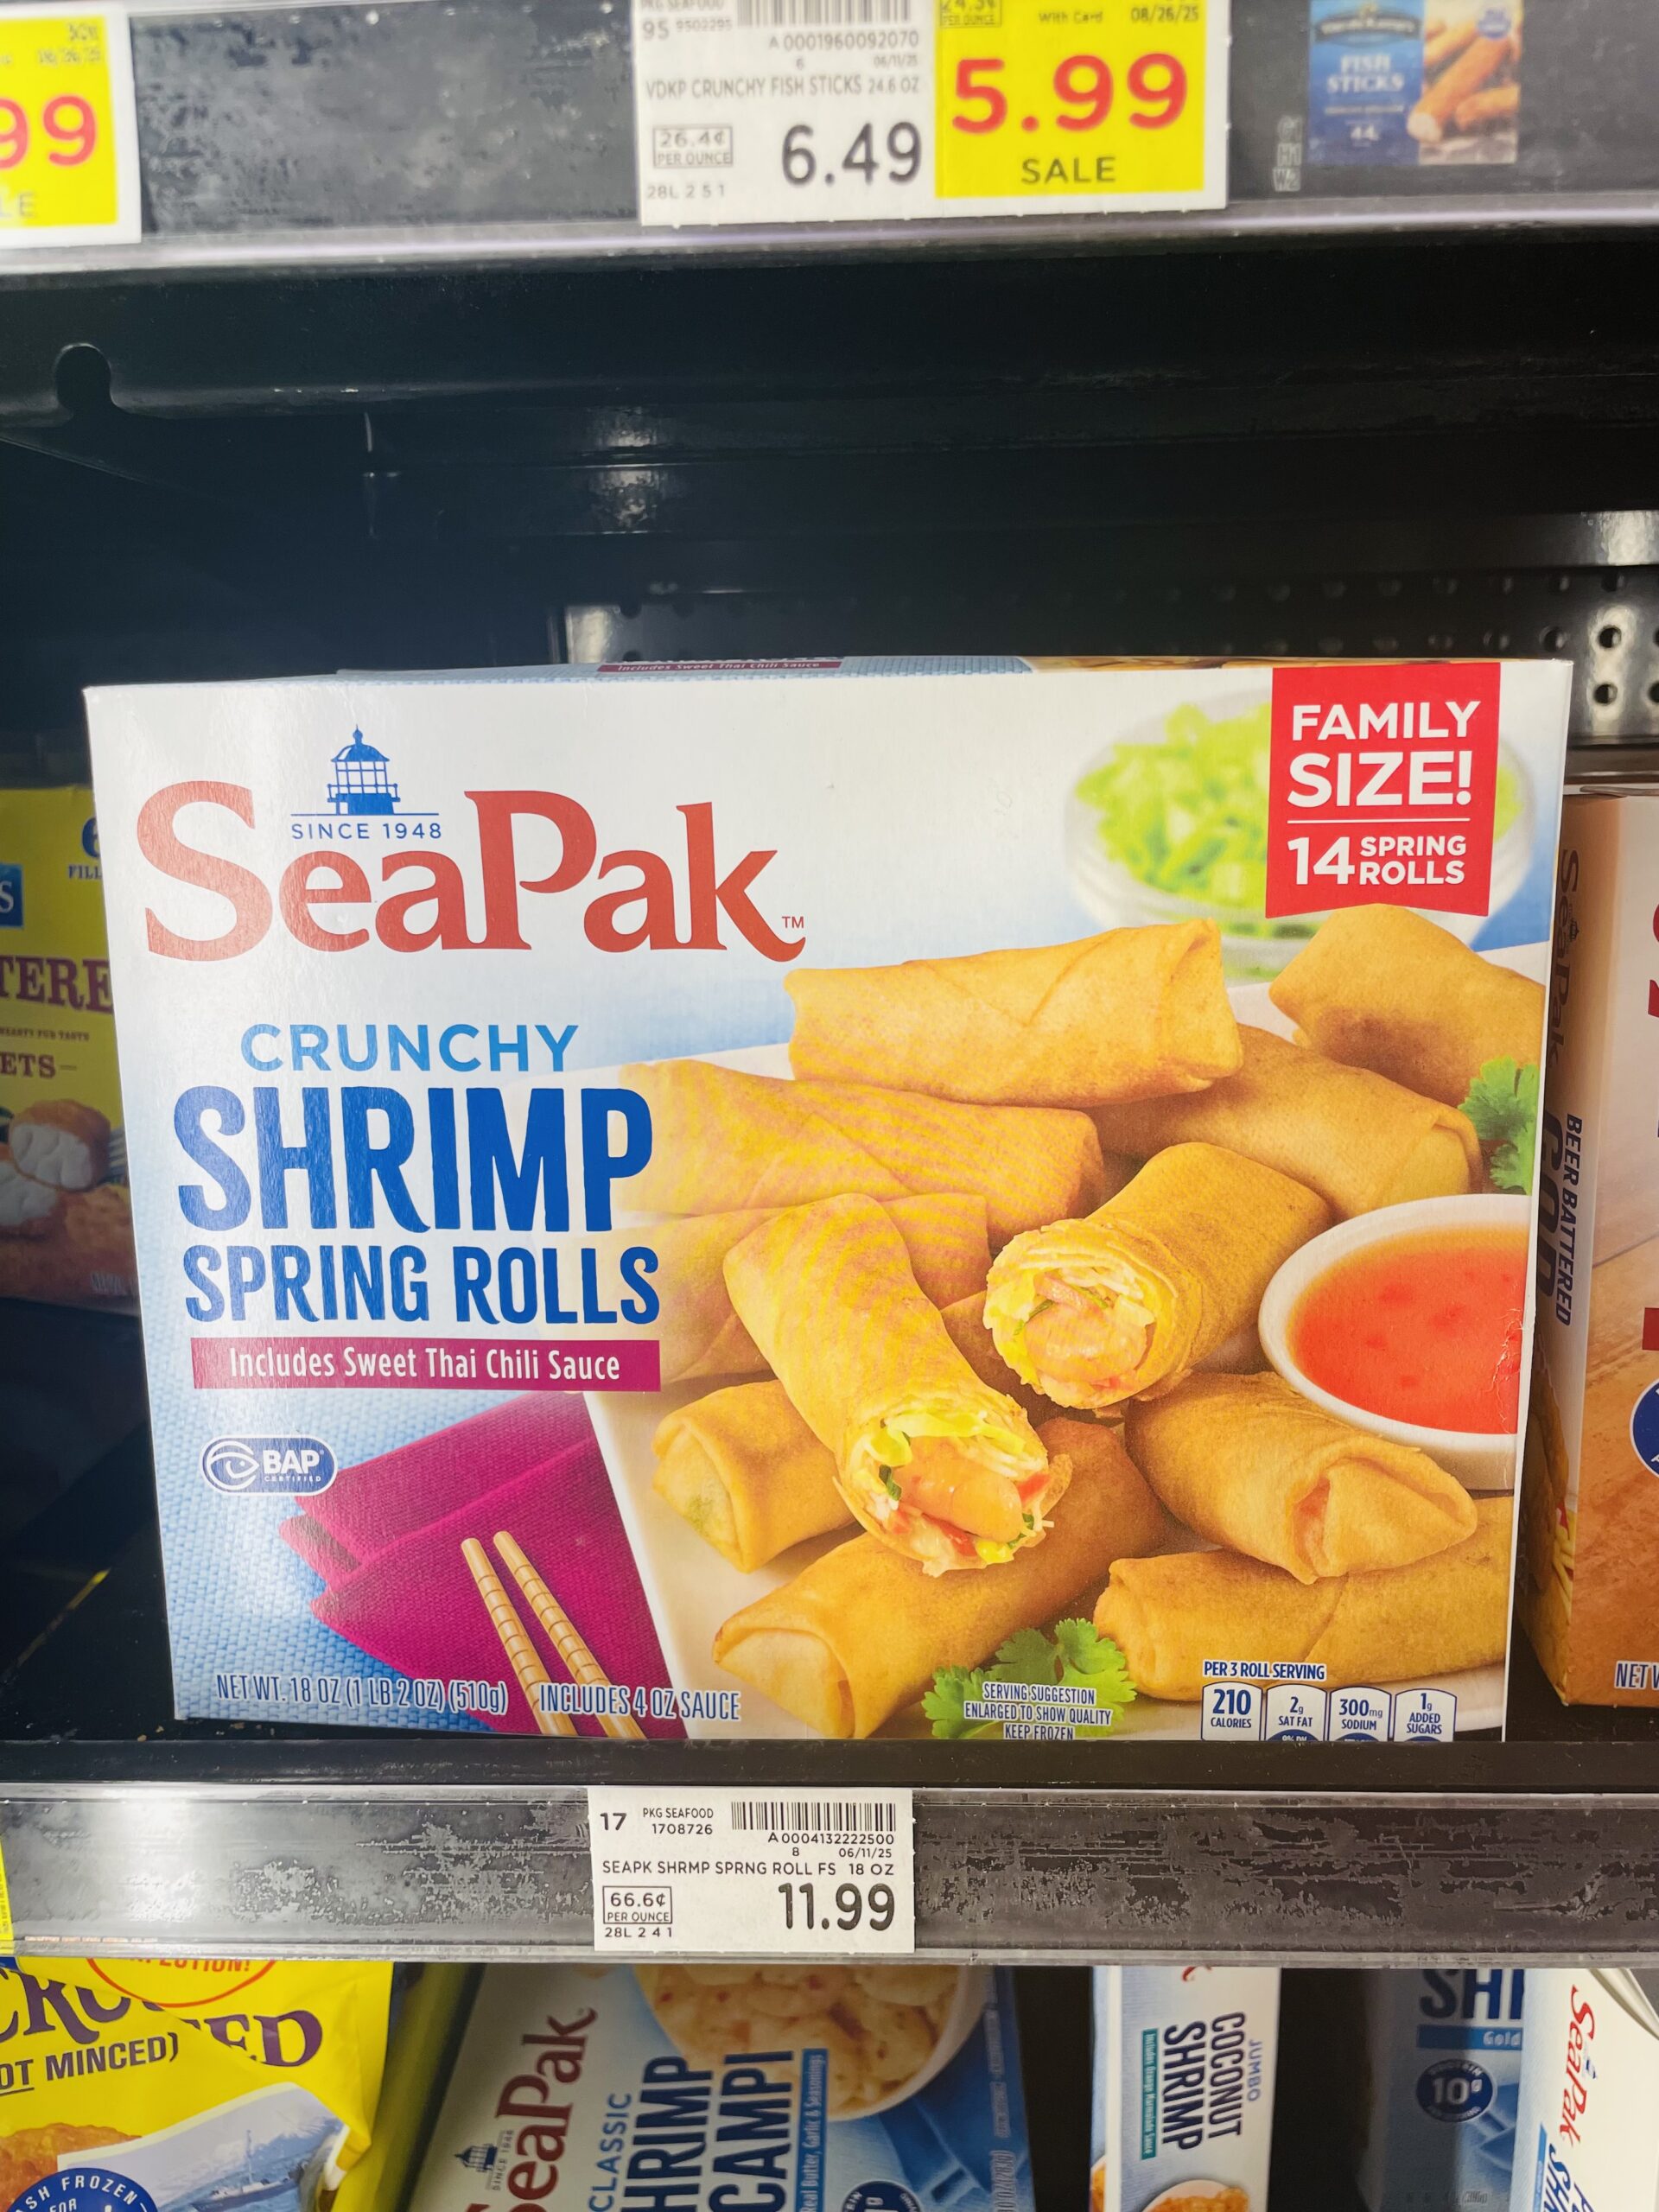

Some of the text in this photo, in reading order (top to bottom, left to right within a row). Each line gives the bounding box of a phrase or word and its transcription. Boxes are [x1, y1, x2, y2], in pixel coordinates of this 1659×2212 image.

[1073, 11, 1103, 24] Card
[1131, 6, 1199, 25] 08/26/25
[642, 20, 670, 41] 95
[783, 30, 919, 52] 0001960092070
[645, 74, 920, 99] VDKP CRUNCHY FISH STICKS 24.6 OZ
[952, 52, 1188, 135] 5.99
[658, 150, 732, 166] PER OUNCE
[781, 121, 922, 187] 6.49
[1020, 156, 1116, 185] SALE
[646, 186, 679, 200] 28L
[686, 185, 696, 199] 2
[1292, 701, 1481, 741] FAMILY
[1287, 750, 1473, 809] SIZE!
[291, 822, 442, 841] SINCE 1948
[1359, 835, 1467, 857] SPRING
[1287, 836, 1356, 887] 14
[1359, 860, 1466, 887] ROLLS
[240, 1023, 578, 1072] CRUNCHY
[174, 1085, 653, 1233] SHRIMP
[1555, 1112, 1582, 1326] BEER BATTERED
[182, 1244, 660, 1325] SPRING ROLLS
[229, 1346, 620, 1382] Includes Sweet Thai Chili Sauce
[262, 1449, 321, 1474] BAP
[1204, 1661, 1325, 1681] PER 3 ROLL SERVING
[1616, 1662, 1649, 1688] NET
[216, 1675, 507, 1713] NET WT. 18 OZ (1 LB 2 OZ) (510g)
[540, 1684, 740, 1720] INCLUDES 4 OZ SAUCE
[983, 1683, 1096, 1705] SERVING SUGGESTION
[1212, 1688, 1252, 1715] 210
[1421, 1693, 1433, 1712] 1g
[965, 1702, 1112, 1726] ENLARGED TO SHOW QUALITY
[1289, 1696, 1304, 1715] 2g
[1338, 1699, 1383, 1719] 300mg
[1211, 1717, 1252, 1728] CALORIES
[1279, 1715, 1313, 1727] SAT FAT
[1341, 1719, 1377, 1731] SODIUM
[1407, 1723, 1443, 1735] SUGARS
[1409, 1713, 1441, 1724] ADDED
[1005, 1725, 1074, 1740] KEEP FROZEN
[600, 1813, 627, 1831] 17
[643, 1807, 714, 1819] PKG SEAFOOD
[652, 1823, 713, 1835] 1708726
[768, 1833, 894, 1846] A 0004132222500
[792, 1847, 799, 1857] 8
[839, 1847, 893, 1859] 06/11/25
[602, 1860, 894, 1875] SEAPK SHRMP SPRNG ROLL FS 18 OZ
[610, 1891, 666, 1907] 66.6¢
[779, 1882, 895, 1931] 11.99
[607, 1911, 671, 1923] PER OUNCE
[604, 1927, 672, 1938] 28L 2 4 1
[46, 2031, 179, 2081] MINCED)
[1559, 1985, 1595, 2145] SeaPak
[1209, 2012, 1246, 2139] COCONUT
[1247, 2040, 1262, 2101] JUMBO
[1162, 2020, 1207, 2150] SHRIMP
[467, 2007, 598, 2212] eaPak
[589, 2092, 632, 2212] CLASSIC
[61, 2175, 137, 2206] FROZEN
